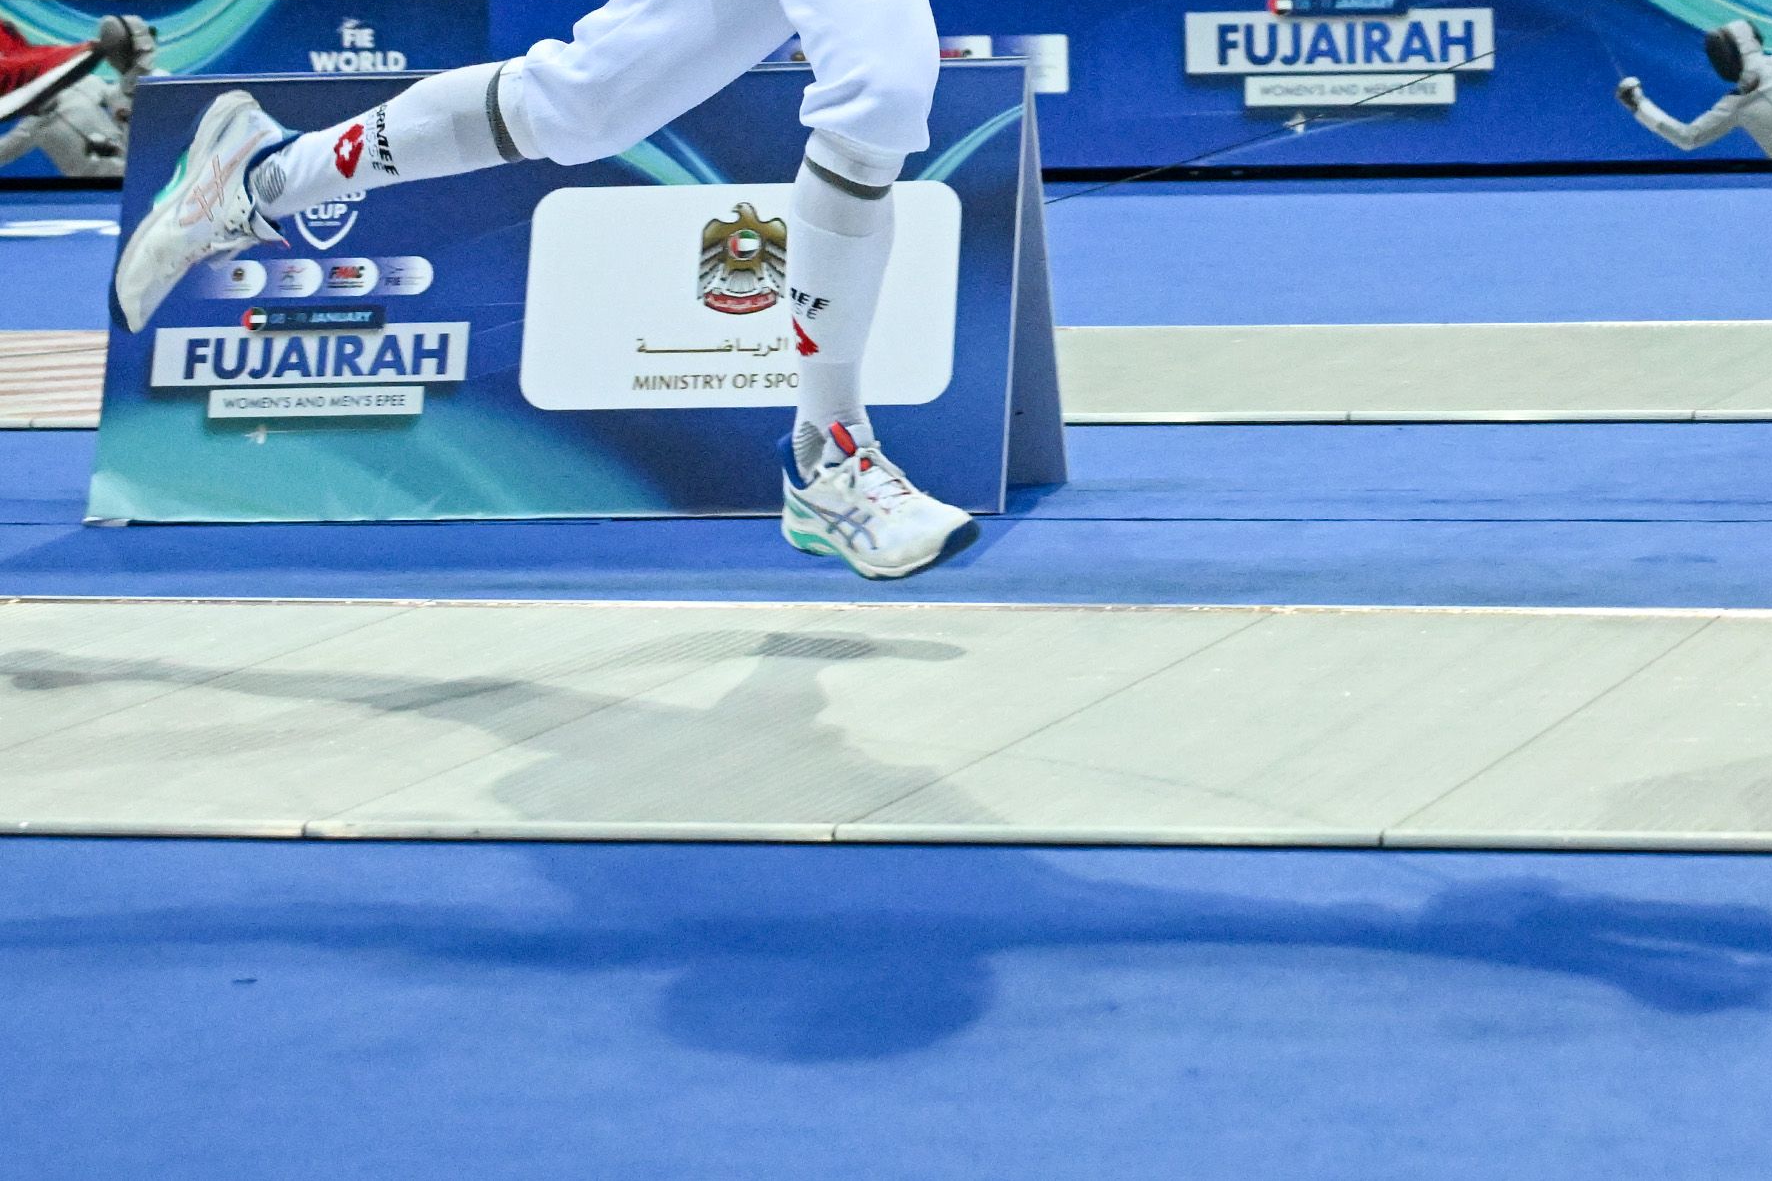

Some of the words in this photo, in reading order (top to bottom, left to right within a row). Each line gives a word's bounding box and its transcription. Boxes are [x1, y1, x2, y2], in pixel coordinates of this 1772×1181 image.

[342, 28, 376, 49] FIE
[1217, 20, 1475, 67] FUJAIRAH
[309, 50, 408, 73] WORLD
[303, 203, 348, 220] CUP
[183, 332, 451, 380] FUJAIRAH
[632, 373, 728, 391] MINISTRY
[731, 373, 760, 389] OF
[763, 371, 800, 389] SPO
[223, 396, 291, 410] WOMEN'S
[294, 395, 325, 409] AND
[331, 395, 373, 408] MEN'S
[375, 394, 406, 407] EPEE
